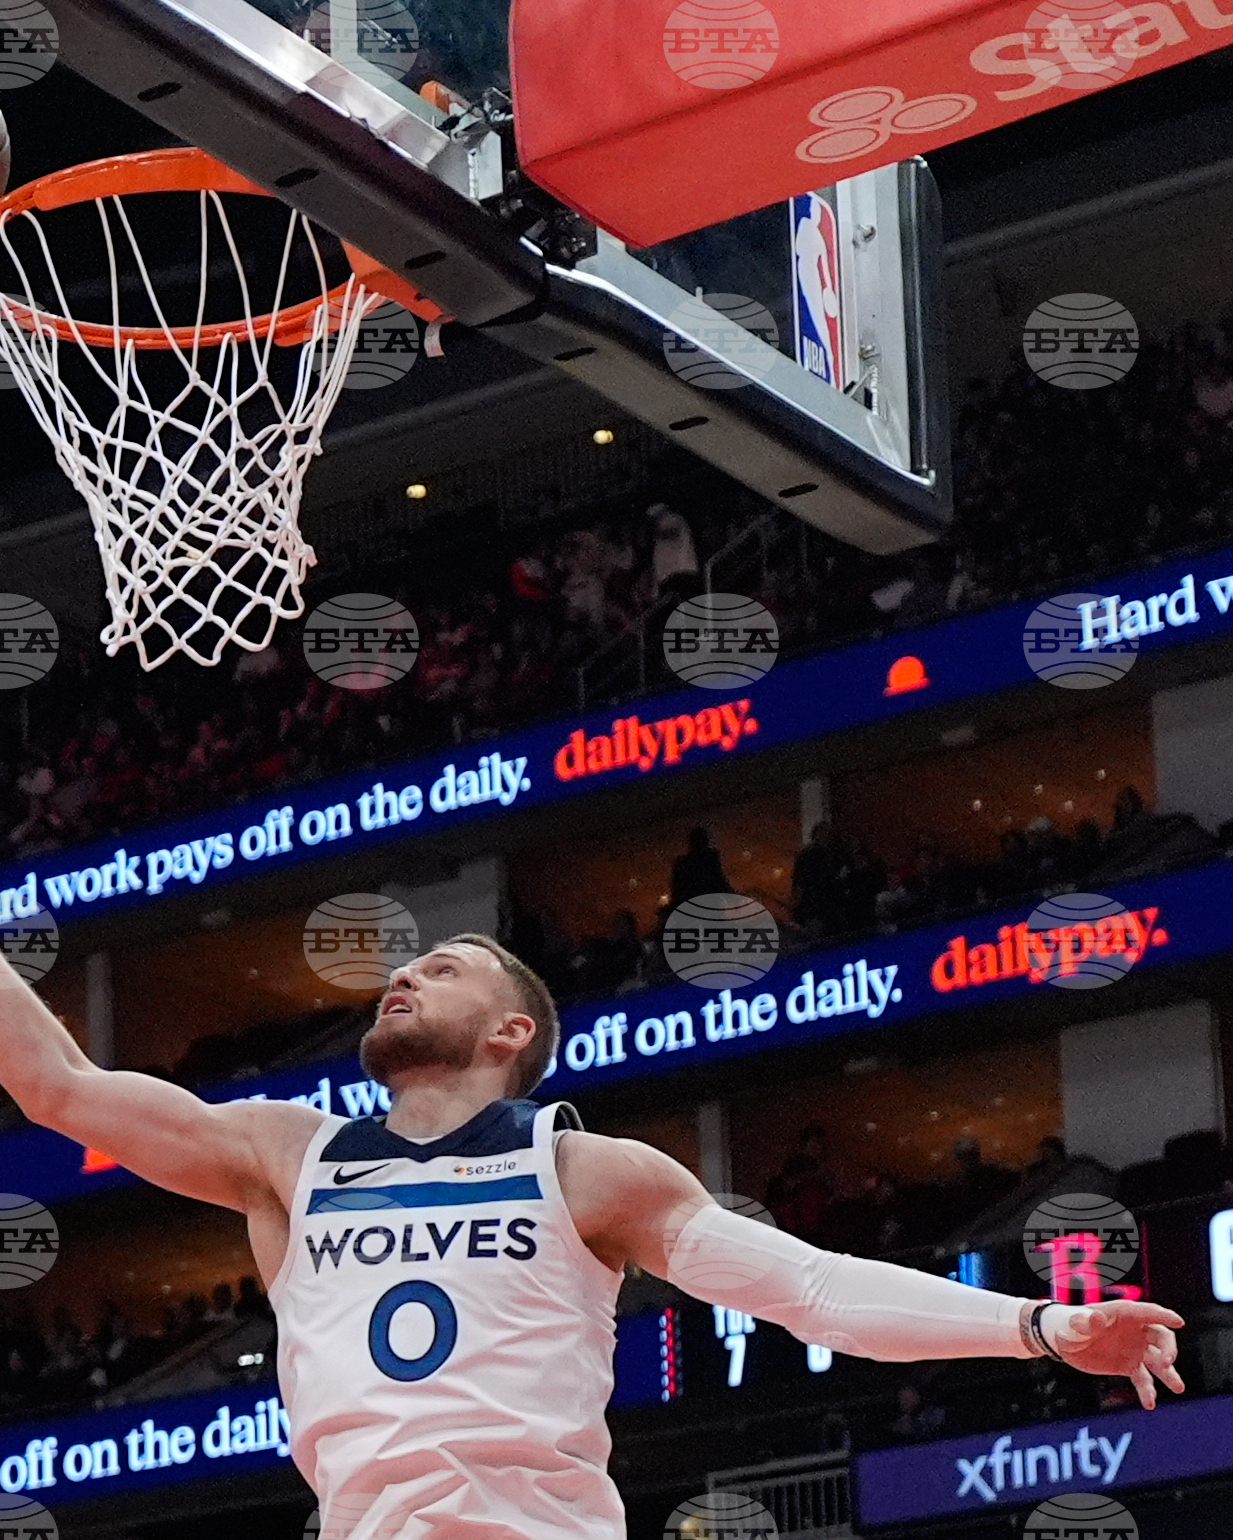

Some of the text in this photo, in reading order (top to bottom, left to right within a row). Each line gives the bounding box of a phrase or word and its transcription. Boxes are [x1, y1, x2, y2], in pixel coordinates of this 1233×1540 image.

[970, 0, 1233, 101] Sta
[1078, 575, 1200, 652] Hard
[553, 698, 758, 782] dailypay.
[44, 848, 143, 909] work
[144, 829, 234, 895] pays
[239, 805, 295, 861] off
[299, 802, 354, 847] on
[357, 782, 424, 831] the
[429, 751, 532, 806] daily.
[930, 906, 1169, 993] dailypay.
[565, 1011, 628, 1071] off
[634, 1009, 696, 1056] on
[700, 988, 778, 1042] the
[785, 958, 903, 1025] daily.
[465, 1159, 517, 1176] sezzle
[304, 1217, 538, 1275] WOLVES
[368, 1279, 458, 1383] 0
[724, 1333, 747, 1388] 7
[0, 1435, 58, 1493] off
[62, 1435, 122, 1482] on
[123, 1418, 195, 1471] the
[956, 1425, 1132, 1502] xfinity
